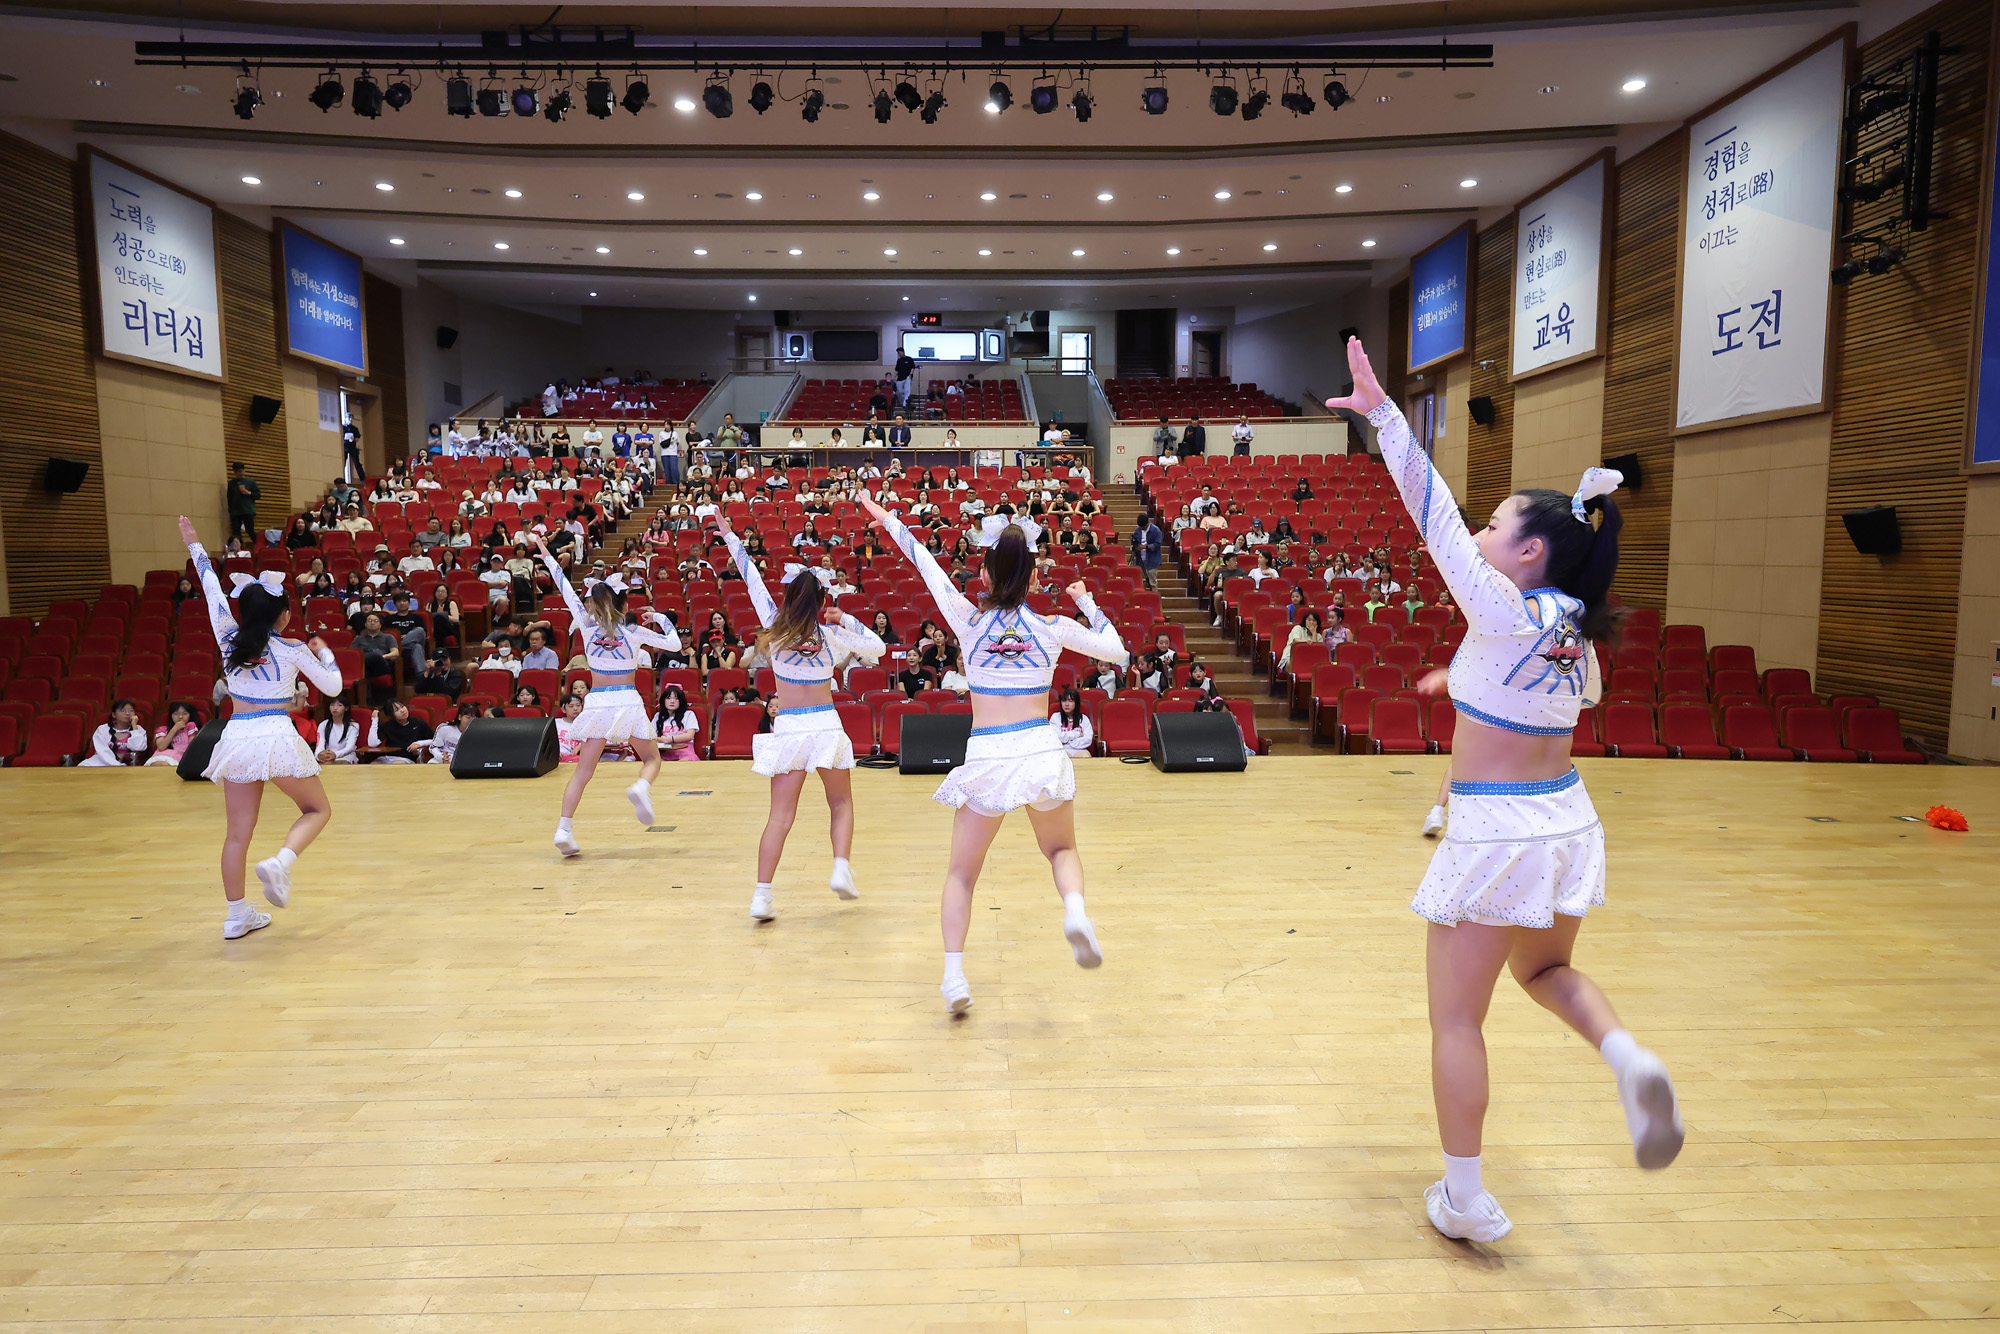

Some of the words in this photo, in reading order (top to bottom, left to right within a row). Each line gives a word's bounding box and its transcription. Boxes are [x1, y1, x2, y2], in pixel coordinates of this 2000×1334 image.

[1703, 140, 1751, 181] 경험을
[1701, 168, 1774, 220] 성취로(路)
[110, 197, 156, 235] 노력을
[112, 232, 186, 276] 성공으로(路)
[1526, 224, 1553, 254] 상상을
[1699, 225, 1738, 254] 이끄는
[114, 266, 165, 296] 인도하는
[1525, 248, 1567, 283] 현실로(路)
[1523, 287, 1547, 310] 만드는
[122, 298, 203, 359] 리더십
[1533, 302, 1575, 351] 교육
[1711, 289, 1782, 357] 도전
